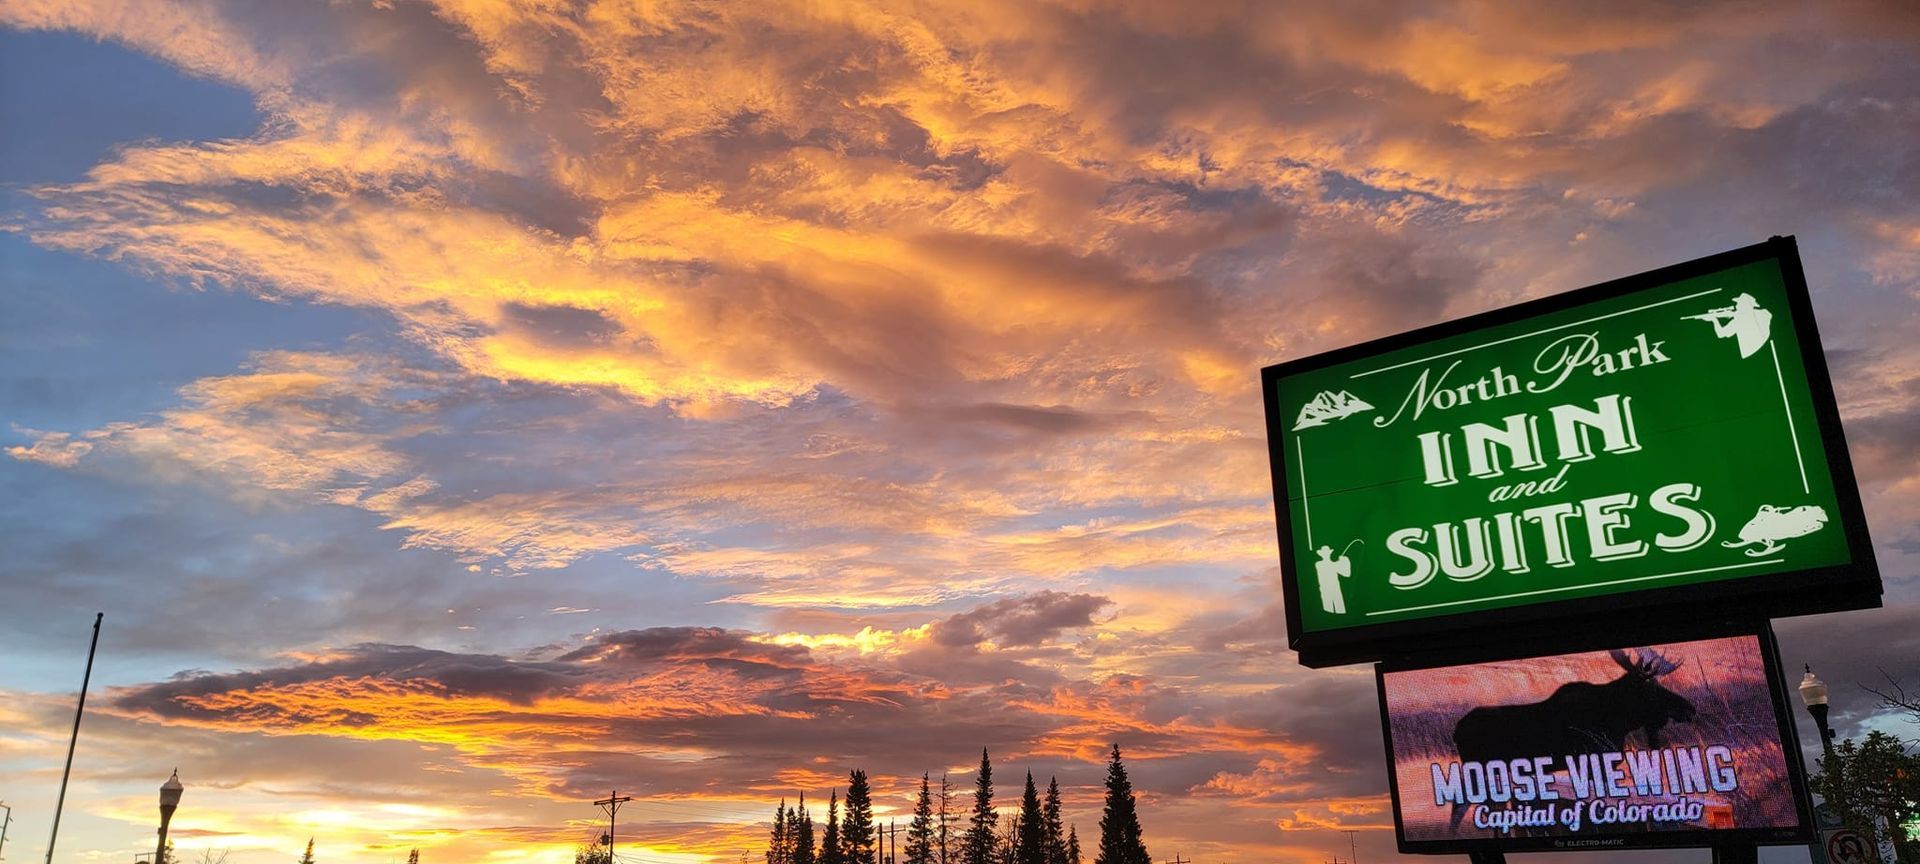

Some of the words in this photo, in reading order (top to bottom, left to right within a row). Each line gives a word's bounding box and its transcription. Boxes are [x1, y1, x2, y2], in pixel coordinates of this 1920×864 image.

[1373, 360, 1522, 427] North
[1526, 331, 1671, 394] Park
[1416, 393, 1642, 488] INN
[1488, 464, 1569, 503] and
[1386, 483, 1716, 590] SUITES
[1431, 756, 1559, 806] MOOSE
[1565, 745, 1738, 802] VIEWING
[1473, 800, 1556, 834] Capital
[1560, 801, 1583, 832] of
[1588, 796, 1705, 824] Colorado
